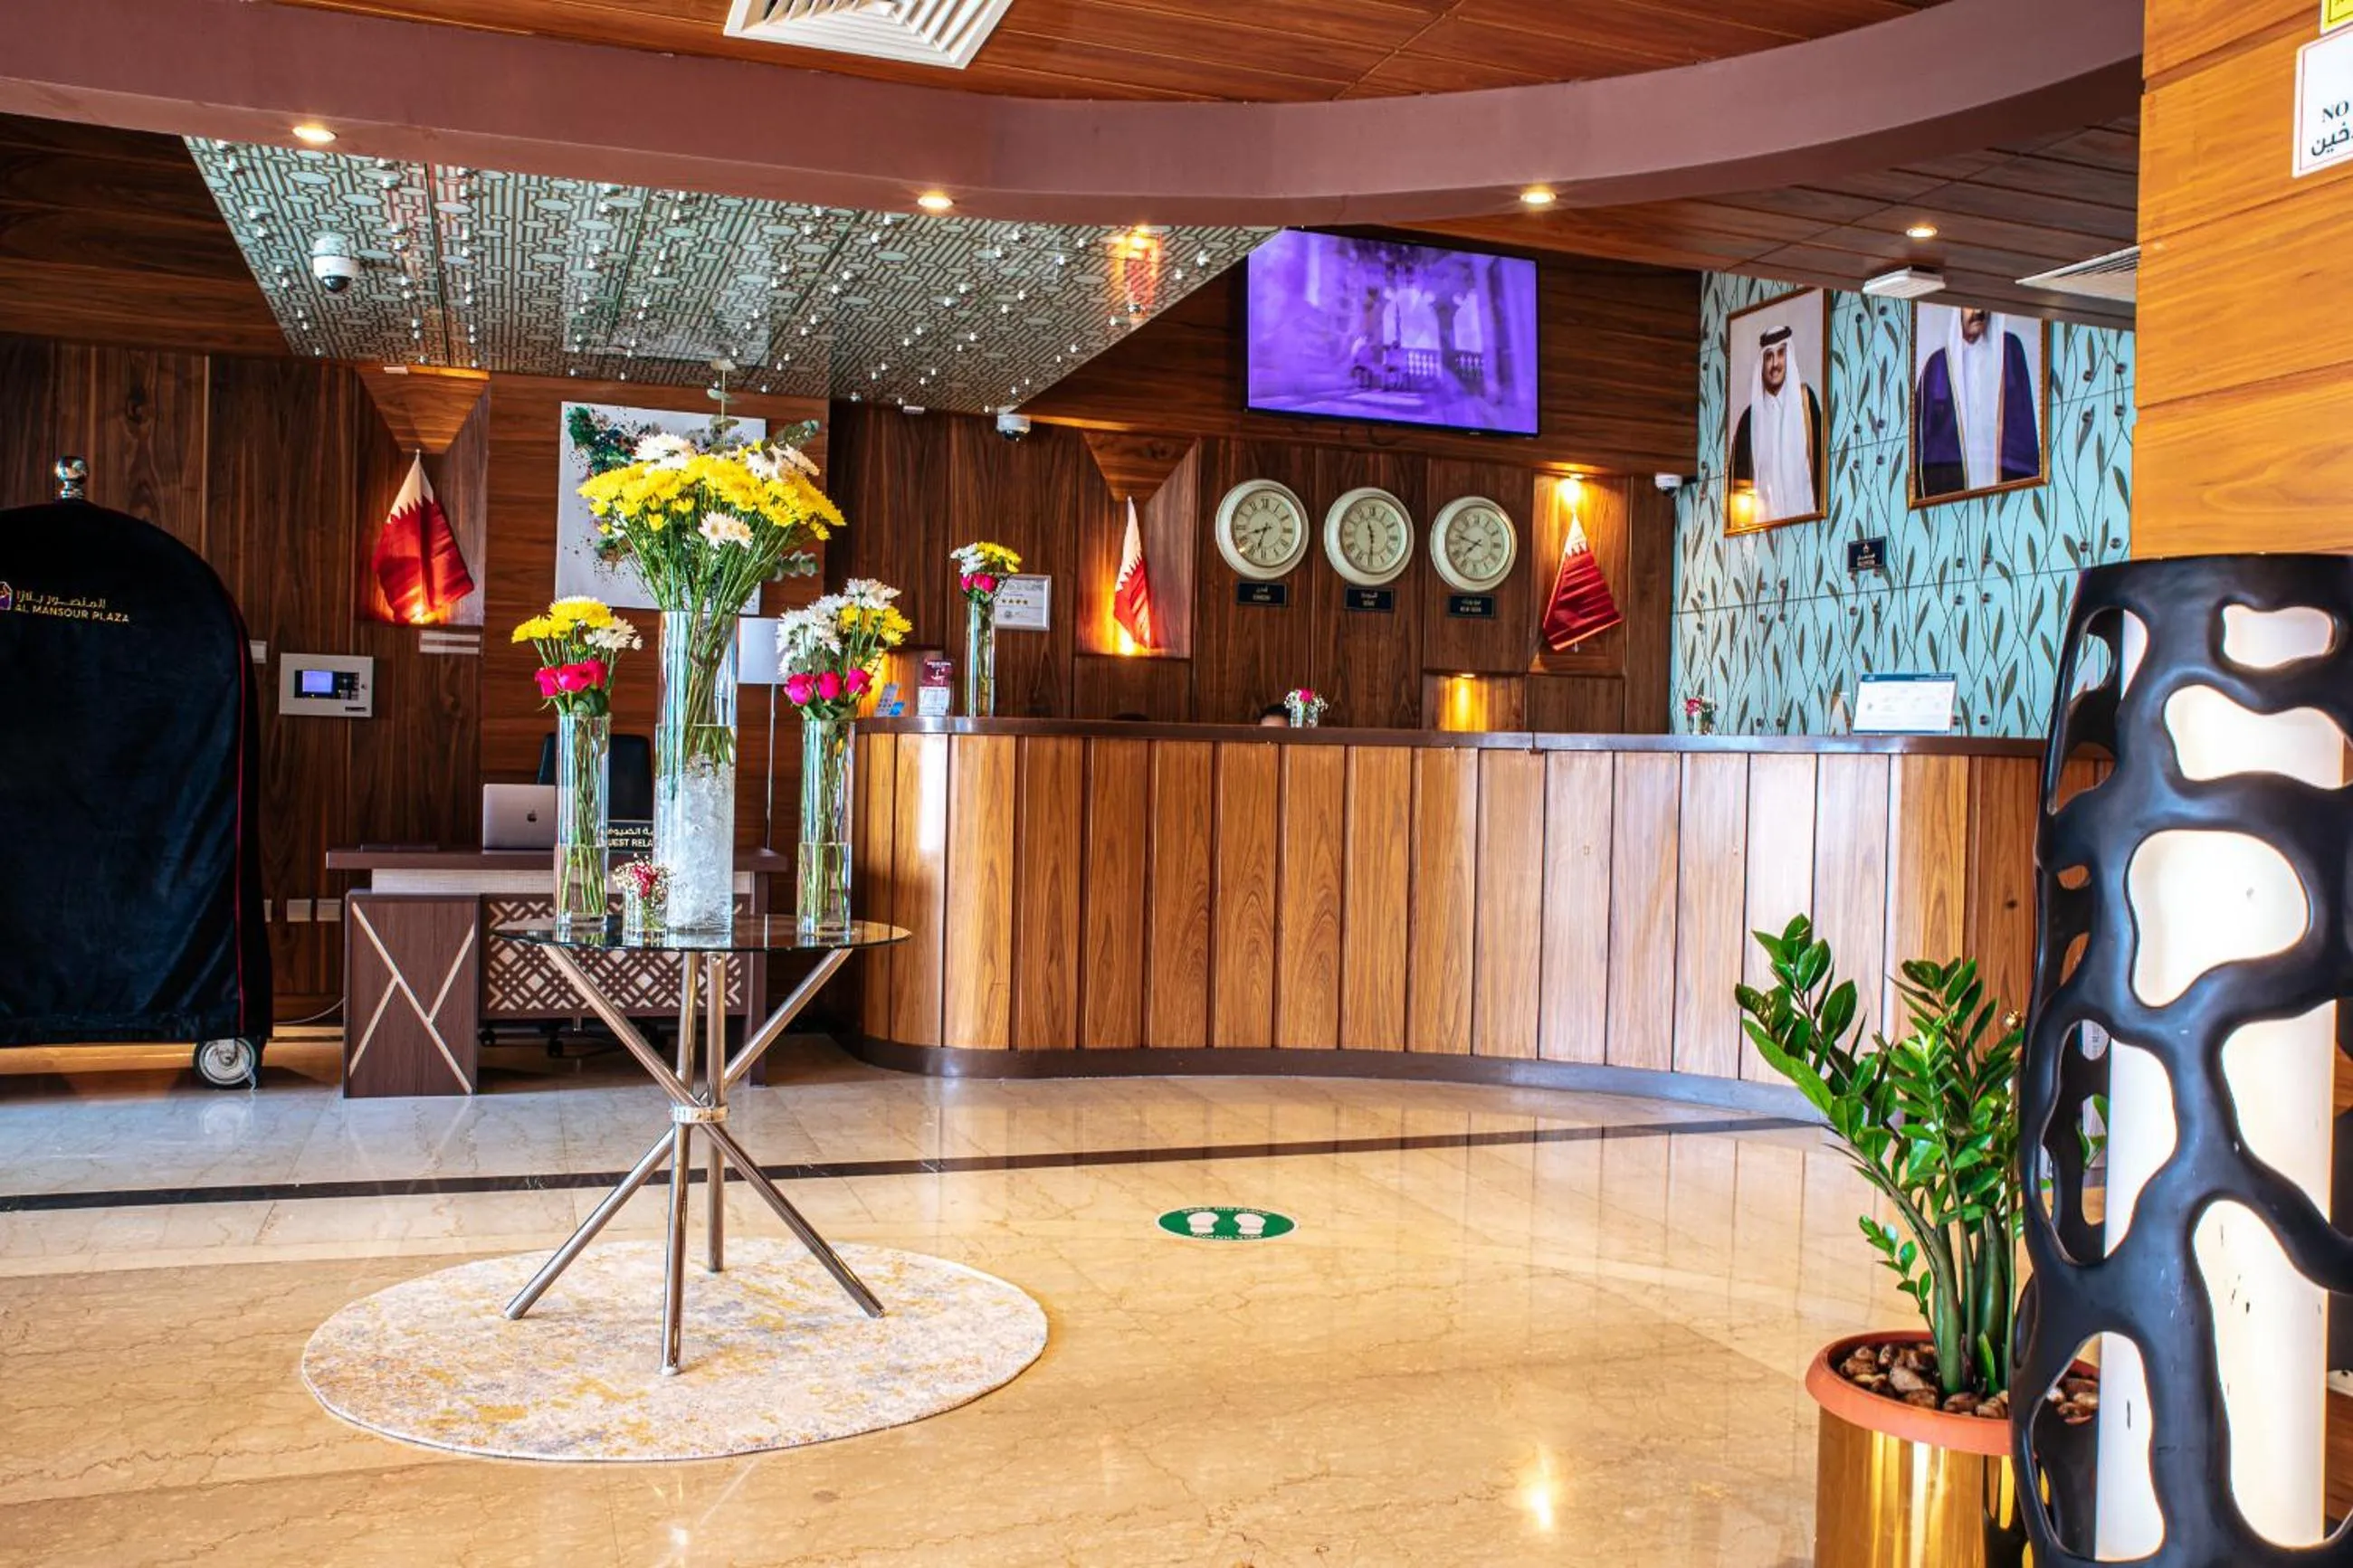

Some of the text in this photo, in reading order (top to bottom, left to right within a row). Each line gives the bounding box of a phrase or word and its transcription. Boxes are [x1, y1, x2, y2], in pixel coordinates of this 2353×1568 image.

[2321, 100, 2349, 123] NO
[15, 603, 129, 622] AL MANSOUR PLAZA
[607, 838, 653, 848] UEST RELA
